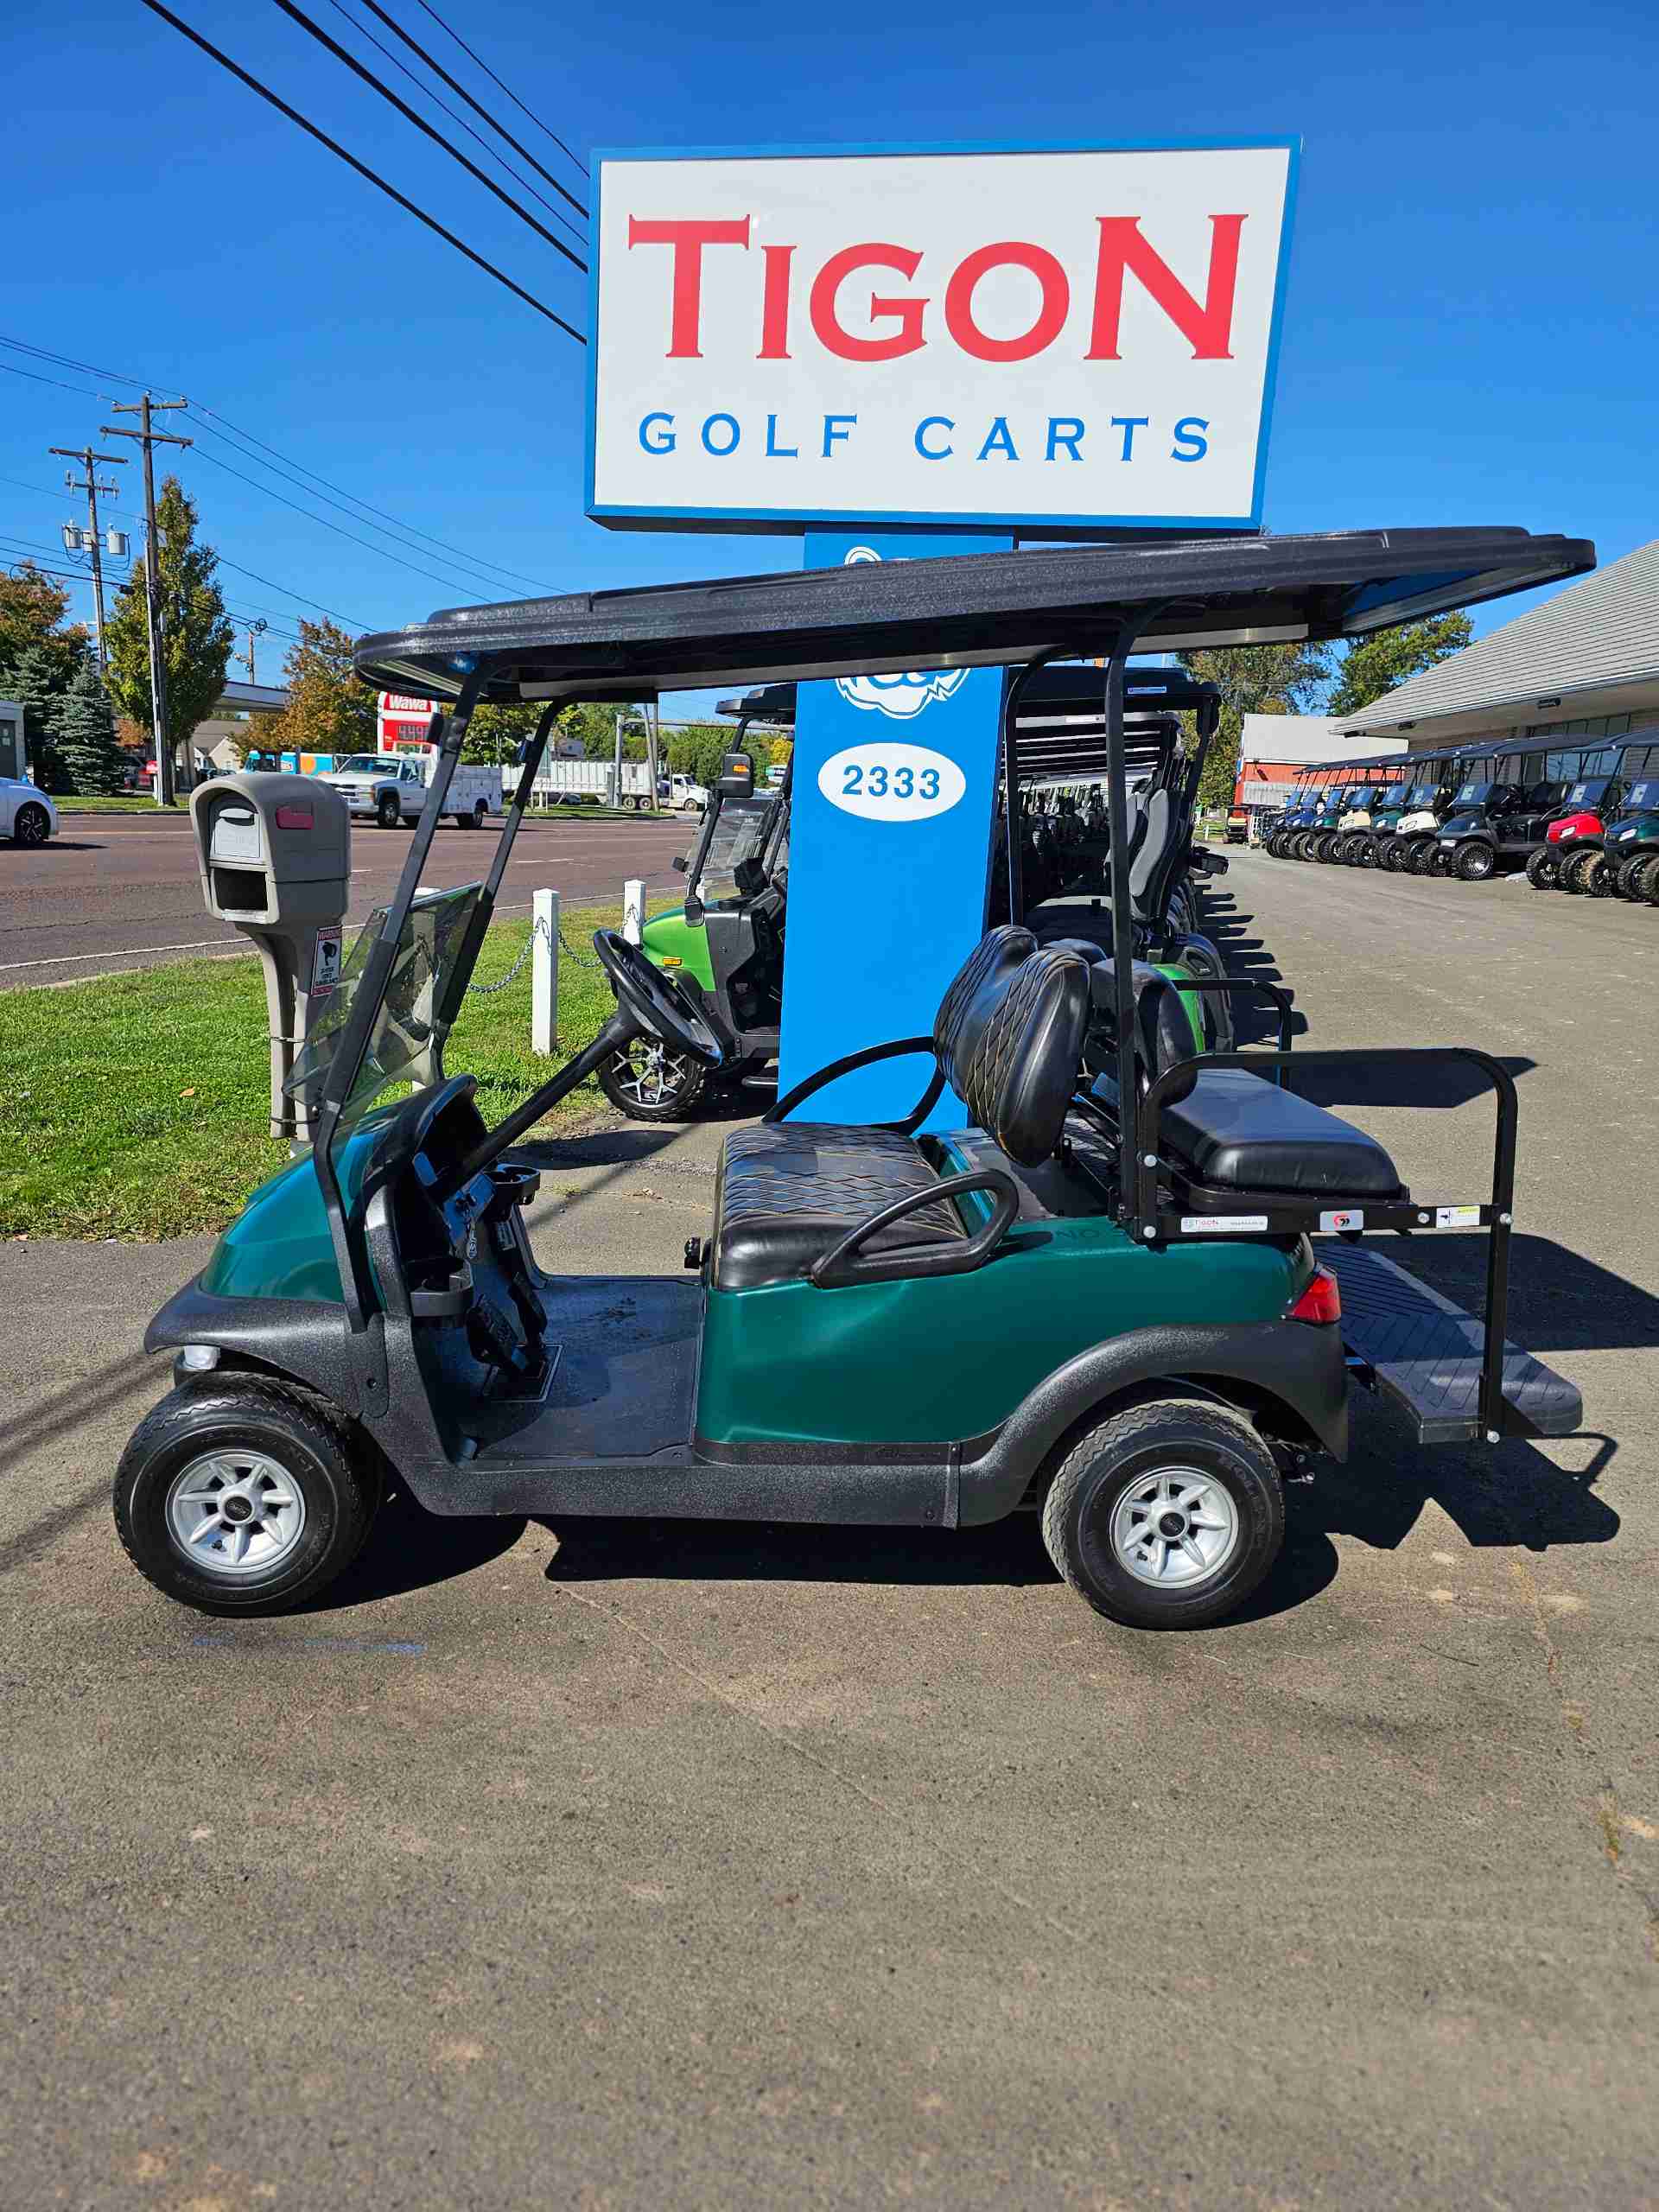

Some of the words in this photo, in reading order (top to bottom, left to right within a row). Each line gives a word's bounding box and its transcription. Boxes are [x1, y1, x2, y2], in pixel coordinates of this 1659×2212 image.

[629, 213, 1249, 362] TIGON
[639, 412, 858, 458] GOLF
[915, 416, 1210, 463] CARTS
[390, 695, 428, 710] Wawa
[842, 765, 940, 800] 2333
